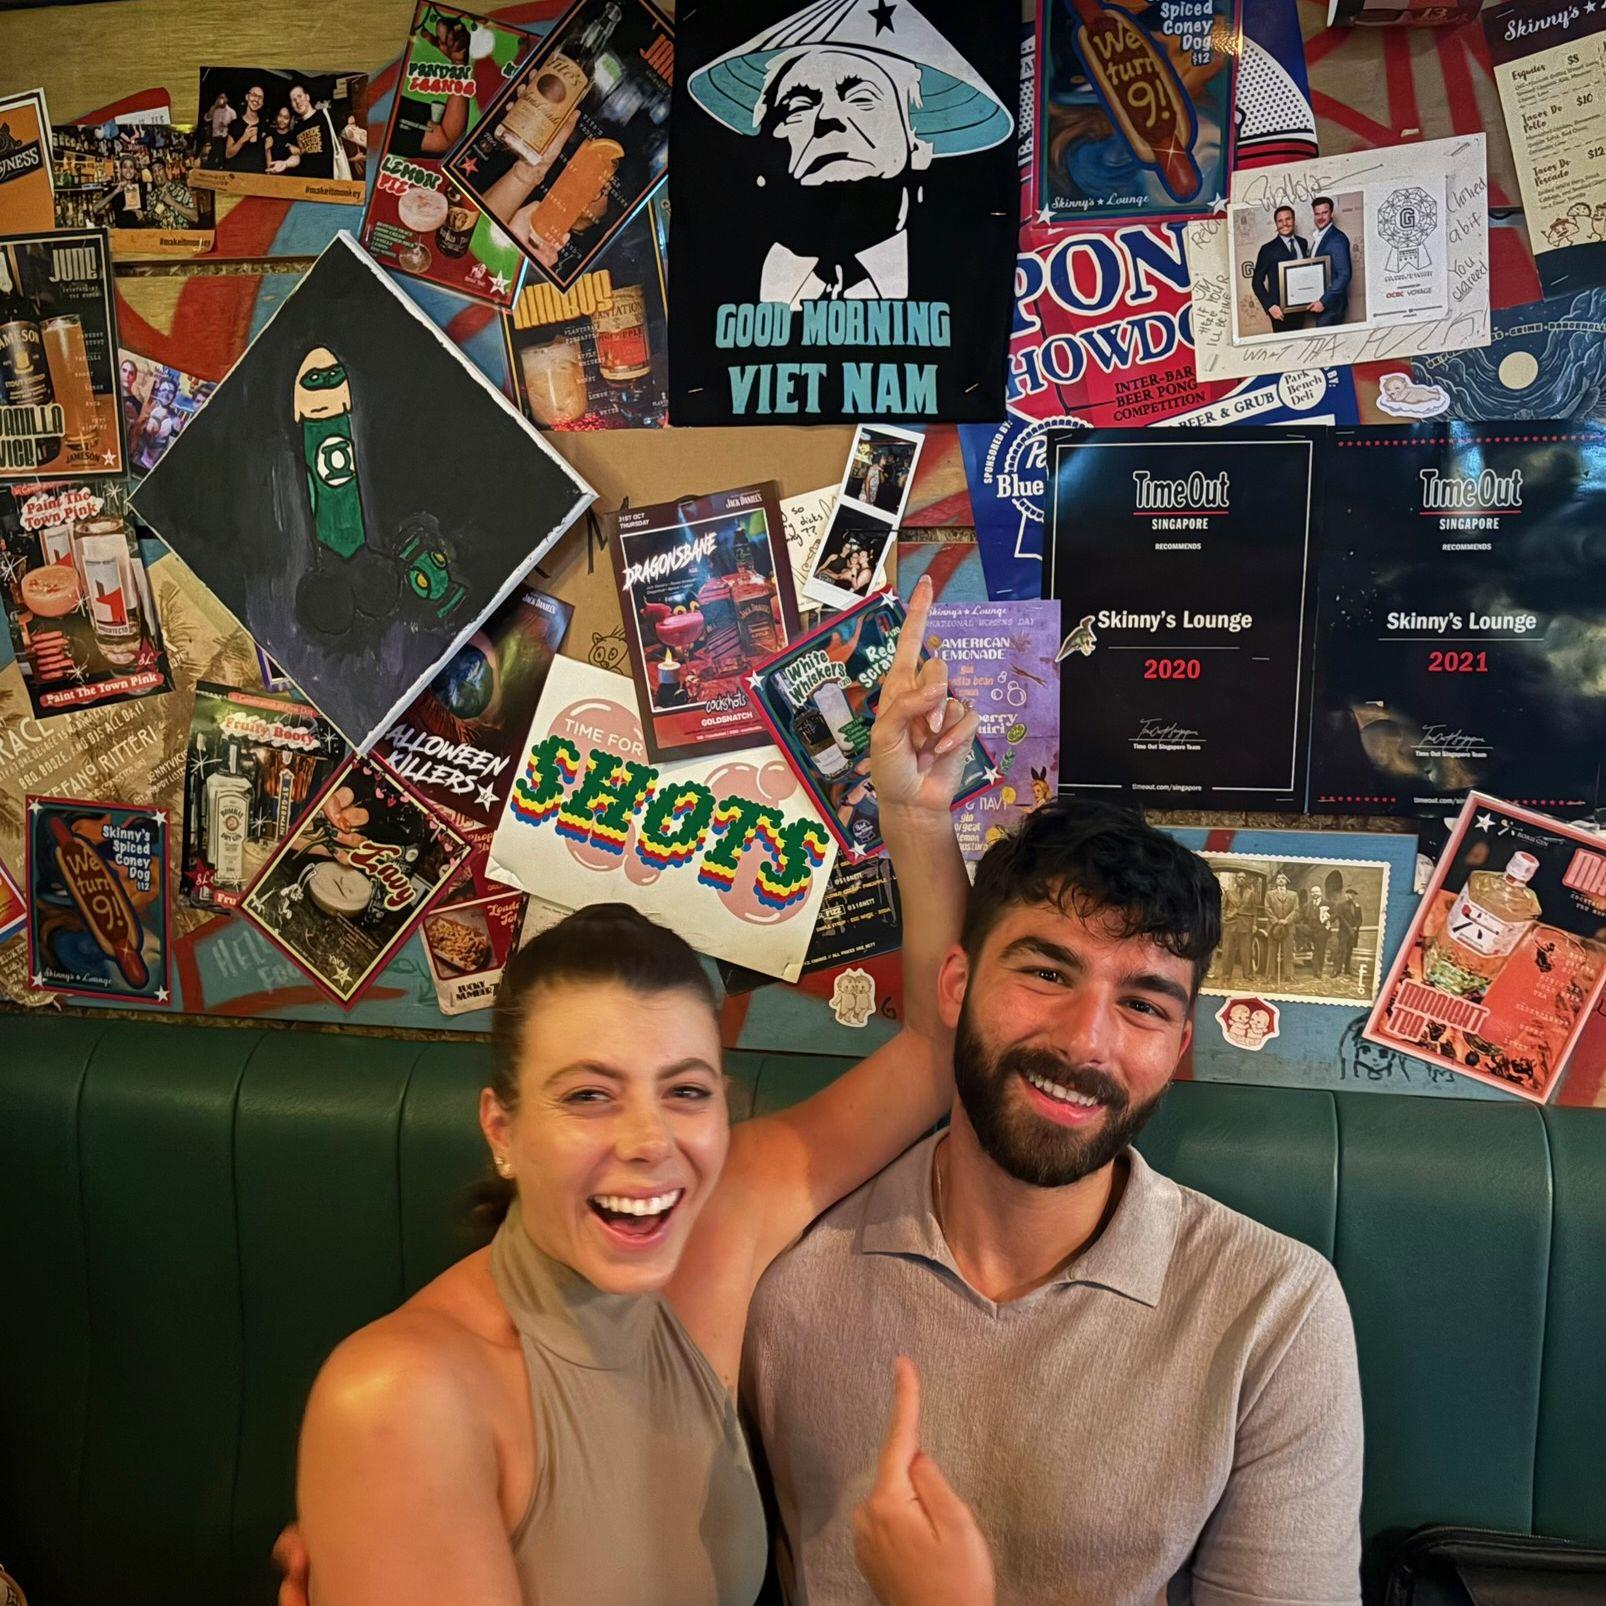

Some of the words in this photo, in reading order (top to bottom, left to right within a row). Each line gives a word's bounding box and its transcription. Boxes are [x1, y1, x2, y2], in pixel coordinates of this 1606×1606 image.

[1160, 0, 1213, 19] Spiced
[1163, 20, 1213, 36] Coney
[1503, 6, 1581, 41] Skinny's
[1093, 21, 1142, 60] We
[1182, 34, 1212, 51] Dog
[1192, 51, 1210, 66] $12
[407, 62, 472, 80] PANDAN
[1106, 58, 1159, 85] turn
[1127, 81, 1170, 128] 9!
[1576, 93, 1594, 107] $10
[1587, 146, 1605, 160] $12
[380, 156, 442, 190] LEMON
[378, 173, 410, 196] PIE
[1051, 195, 1095, 212] Skinny's
[1106, 193, 1150, 208] Lounge
[1399, 207, 1416, 229] G
[715, 301, 792, 348] GOOD
[801, 300, 950, 348] MORNING
[1510, 323, 1543, 337] GRIME
[728, 362, 828, 414] VIET
[841, 362, 938, 414] NAM
[1115, 364, 1196, 394] INTER-BAR
[1284, 370, 1311, 385] Park
[1286, 375, 1323, 396] Bench
[1115, 388, 1154, 408] BEER
[1157, 378, 1199, 398] PONG
[1290, 392, 1316, 407] Deli
[1113, 391, 1207, 422] COMPETITION
[1220, 407, 1232, 419] &
[1234, 391, 1276, 413] GRUB
[0, 404, 65, 437] ANILLA
[984, 432, 1007, 484] SPONSORED
[999, 419, 1014, 435] BY:
[996, 473, 1045, 499] Blue
[26, 496, 61, 515] Paint
[66, 489, 91, 506] The
[24, 511, 61, 529] Town
[64, 499, 98, 519] Pink
[618, 514, 633, 523] 31ST
[633, 512, 646, 521] OCT
[620, 519, 650, 530] THURSDAY
[1152, 517, 1209, 530] SINGAPORE
[1439, 518, 1499, 531] SINGAPORE
[1154, 543, 1202, 551] RECOMMENDS
[1442, 543, 1492, 551] RECOMMENDS
[622, 531, 718, 592] DRAGONSBANE
[1098, 610, 1177, 633] Skinny's
[1183, 610, 1253, 633] Lounge
[1386, 611, 1463, 634] Skinny's
[1468, 611, 1537, 634] Lounge
[865, 639, 897, 663] Red
[941, 637, 1011, 649] AMERICAN
[785, 650, 829, 683] White
[1143, 658, 1201, 679] 2020
[1428, 651, 1489, 673] 2021
[46, 690, 75, 705] Paint
[76, 685, 97, 699] The
[97, 679, 130, 693] Town
[131, 672, 158, 687] Pink
[788, 661, 847, 706] Whiskers
[105, 715, 124, 734] ALL
[701, 711, 753, 727] GOLDSNATCH
[226, 715, 271, 738] Fruity
[273, 726, 316, 746] Booty
[565, 718, 602, 743] TIME
[607, 733, 645, 757] FOR
[386, 751, 480, 794] KILLERS
[1131, 783, 1202, 792] timeout.com/singapore
[510, 734, 831, 911] SHOTS
[103, 825, 150, 844] Skinny's
[112, 840, 150, 856] Spiced
[66, 848, 101, 875] We
[115, 854, 151, 868] Coney
[129, 867, 150, 882] Dog
[76, 876, 115, 896] turn
[92, 895, 124, 930] 9!
[456, 986, 493, 1002] NUMBER
[457, 979, 487, 994] LUCKY
